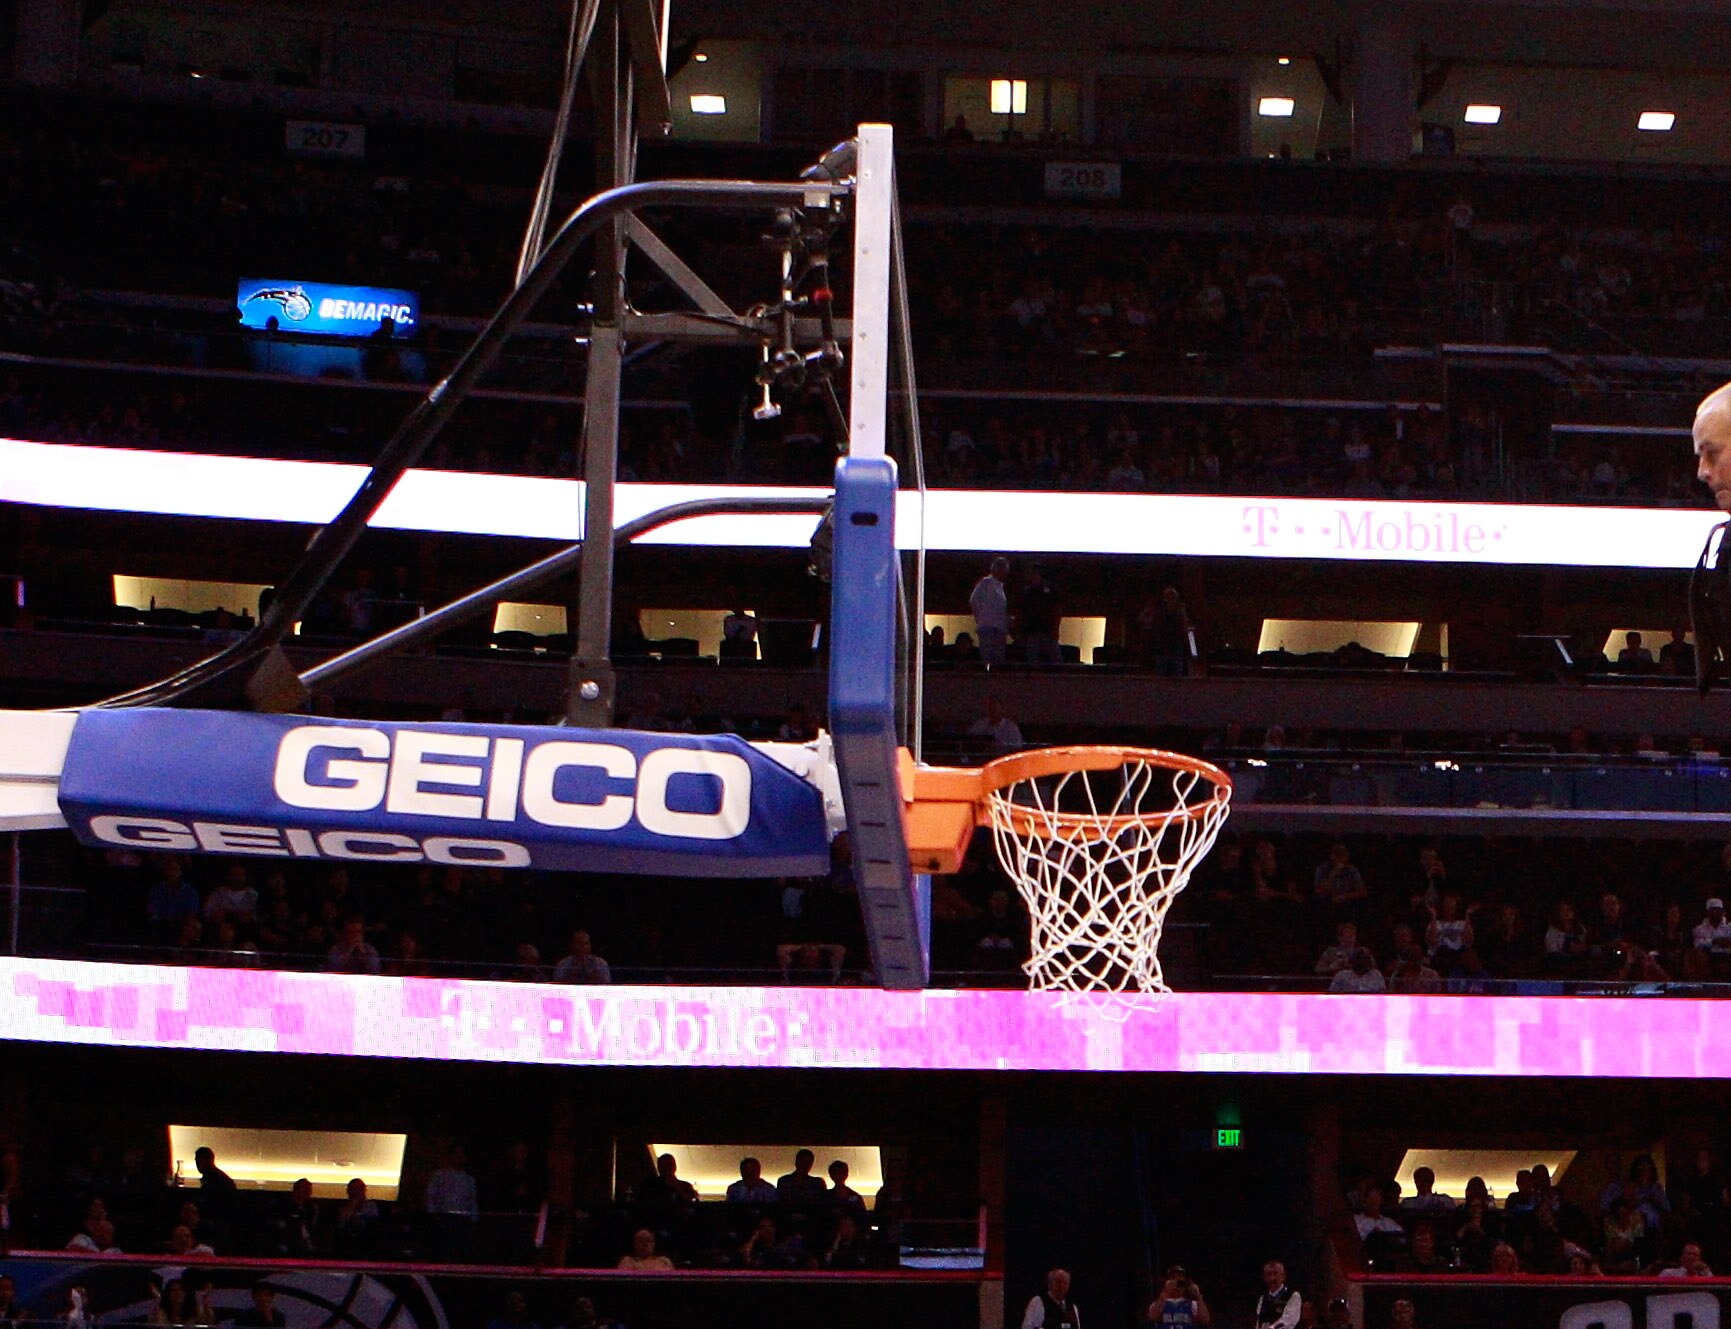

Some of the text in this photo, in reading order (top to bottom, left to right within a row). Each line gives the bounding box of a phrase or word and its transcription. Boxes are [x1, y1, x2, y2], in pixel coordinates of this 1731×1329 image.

[302, 127, 350, 149] 207
[1060, 167, 1105, 190] 208
[275, 726, 751, 840] GEICO
[89, 815, 531, 868] GEICO
[1217, 1129, 1241, 1147] EXIT
